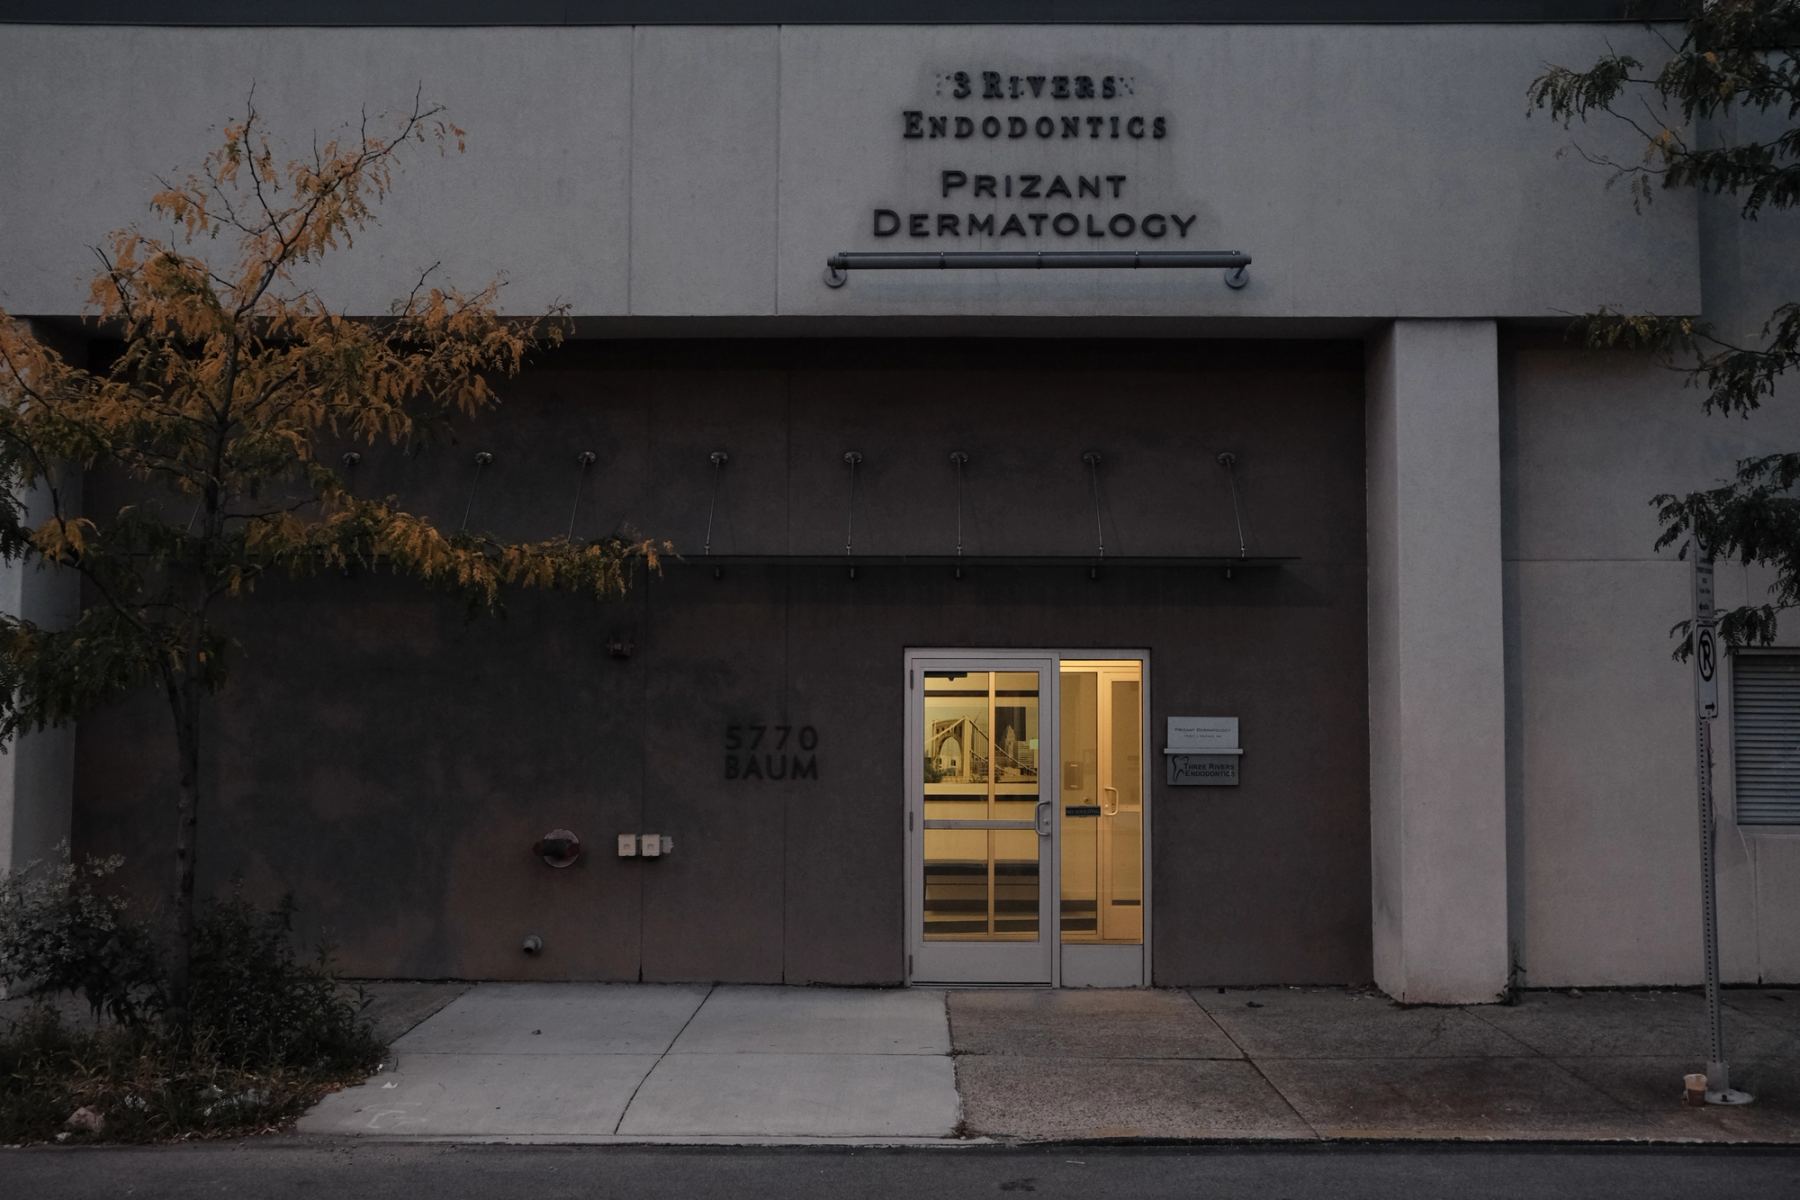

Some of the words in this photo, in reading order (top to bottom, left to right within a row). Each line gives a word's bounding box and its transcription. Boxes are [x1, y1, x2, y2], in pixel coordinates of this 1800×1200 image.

[953, 71, 972, 98] 3
[982, 71, 1117, 98] RIVERS
[903, 111, 1168, 139] ENDODONTICS
[941, 170, 1127, 198] PRIZANT
[873, 208, 1197, 238] DERMATOLOGY
[725, 724, 819, 751] 5770
[724, 753, 819, 781] BAUM
